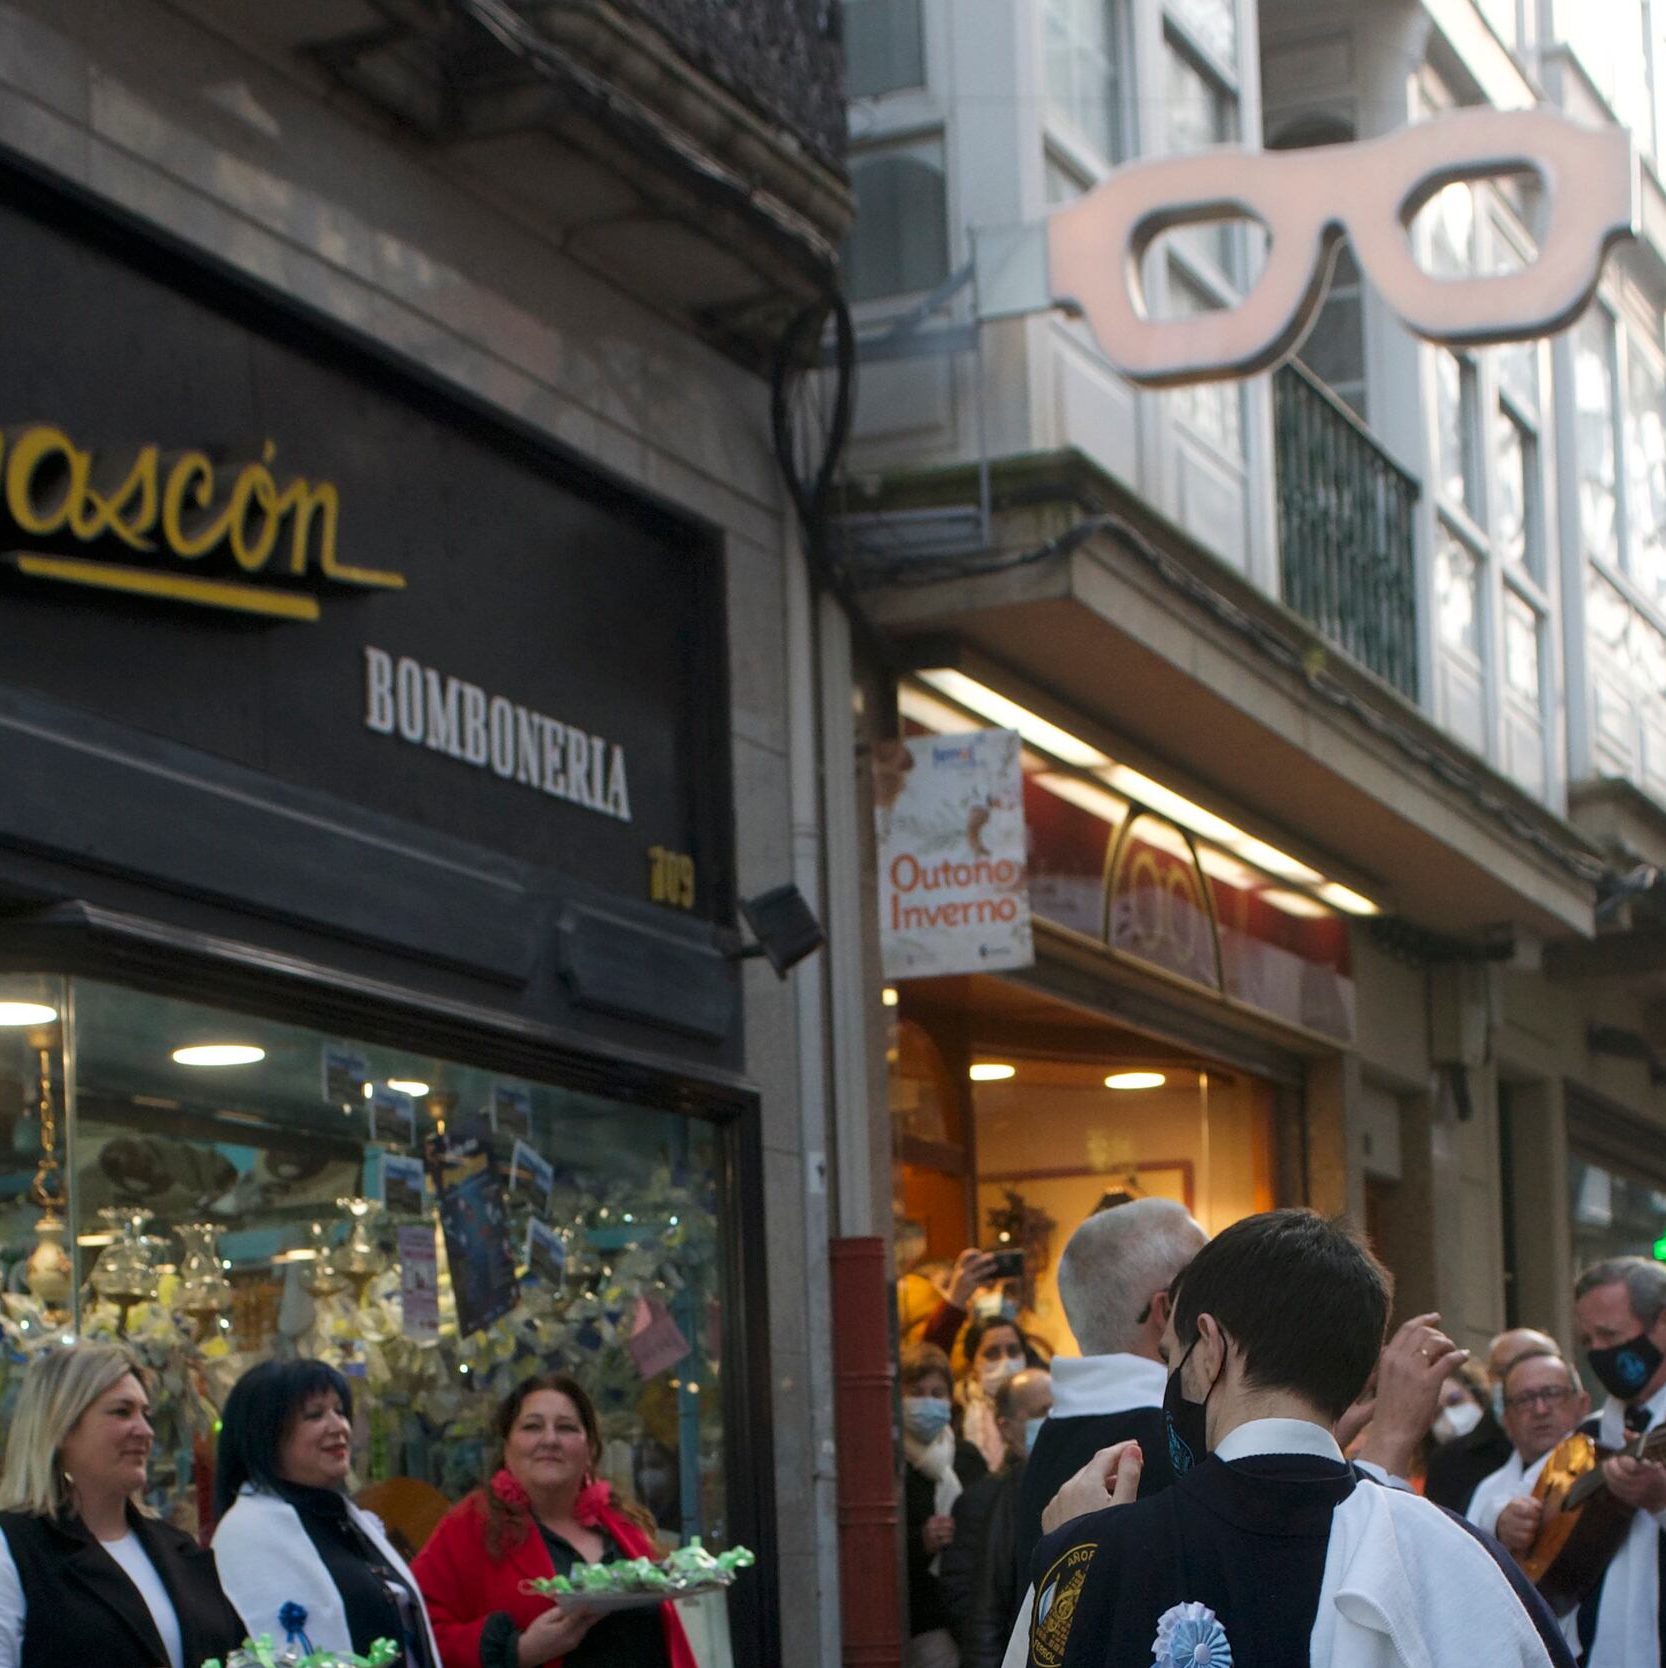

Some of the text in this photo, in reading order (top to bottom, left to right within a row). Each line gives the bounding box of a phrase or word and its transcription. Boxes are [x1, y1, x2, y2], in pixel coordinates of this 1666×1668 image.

[364, 644, 633, 823] BOMBONERIA
[889, 854, 1017, 894] Outono
[890, 896, 1018, 932] Inverno
